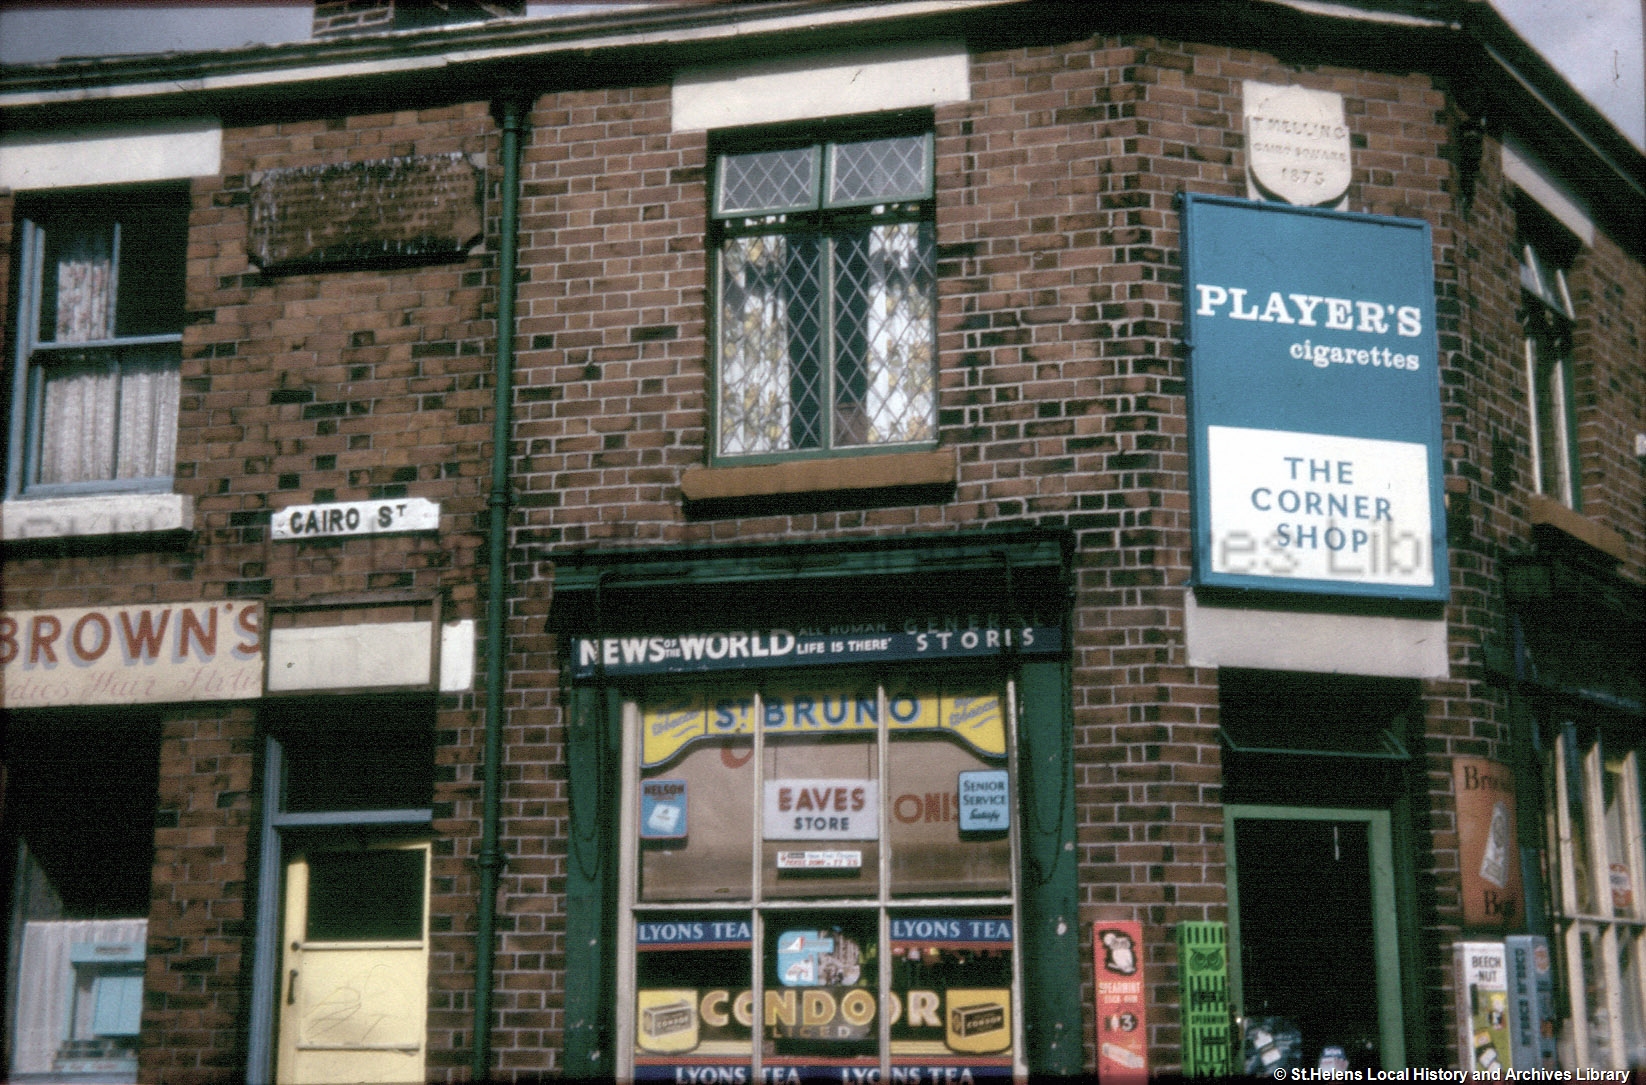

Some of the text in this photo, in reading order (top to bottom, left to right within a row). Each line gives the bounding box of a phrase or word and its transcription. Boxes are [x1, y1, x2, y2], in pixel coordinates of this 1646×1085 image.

[1196, 284, 1422, 337] PLAYER'S
[1289, 340, 1420, 370] cigarettes
[1283, 456, 1354, 485] THE
[1250, 487, 1394, 521] CORNER
[290, 507, 360, 534] CAIRO
[1277, 523, 1369, 553] SHOP
[0, 602, 261, 667] BROWN'S
[830, 623, 886, 635] HUMAN
[579, 637, 664, 666] NEWS
[679, 629, 795, 661] WORLD
[797, 641, 825, 655] LIFE
[831, 641, 844, 653] IS
[763, 693, 921, 728] BRUNO
[963, 780, 1005, 792] SENIOR
[778, 786, 866, 812] EAVES
[963, 794, 1005, 806] SERVICE
[794, 817, 849, 831] STORE
[639, 921, 751, 941] LYONS TEA
[893, 920, 1011, 938] LYONS TEA
[1471, 955, 1502, 968] BEECH
[676, 1066, 746, 1085] LYONS
[842, 1066, 974, 1085] LYONS TEA
